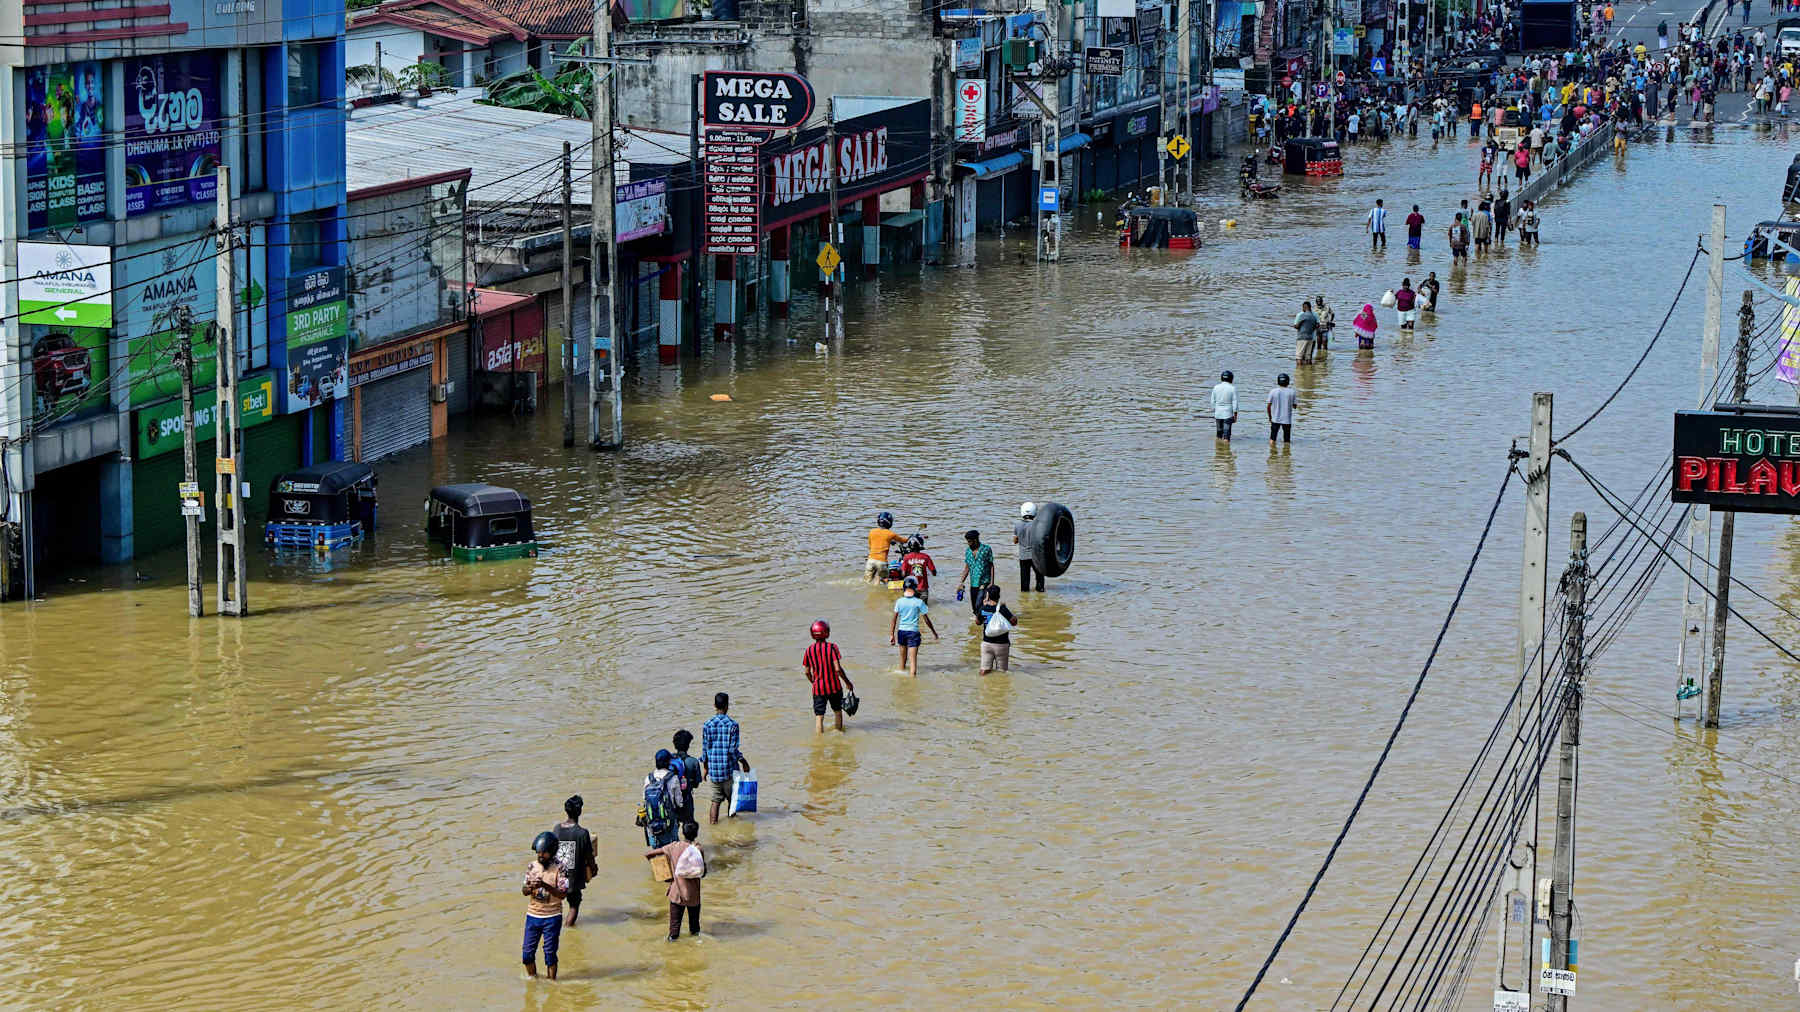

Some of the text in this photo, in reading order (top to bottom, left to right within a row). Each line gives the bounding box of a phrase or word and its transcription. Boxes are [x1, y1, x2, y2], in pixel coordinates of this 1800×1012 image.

[715, 77, 793, 99] MEGA
[718, 102, 787, 124] SALE
[127, 138, 170, 157] DHENUMA
[736, 136, 763, 144] 11.00pm
[774, 126, 888, 207] MEGA SALE
[48, 174, 75, 191] KIDS
[77, 181, 105, 196] BASIC
[48, 197, 76, 209] CLASS
[78, 202, 105, 216] CLASS
[35, 270, 96, 282] AMANA
[142, 275, 198, 303] AMANA
[293, 305, 340, 331] 3RD PARTY
[487, 339, 521, 371] asian
[1719, 427, 1800, 457] HOTE
